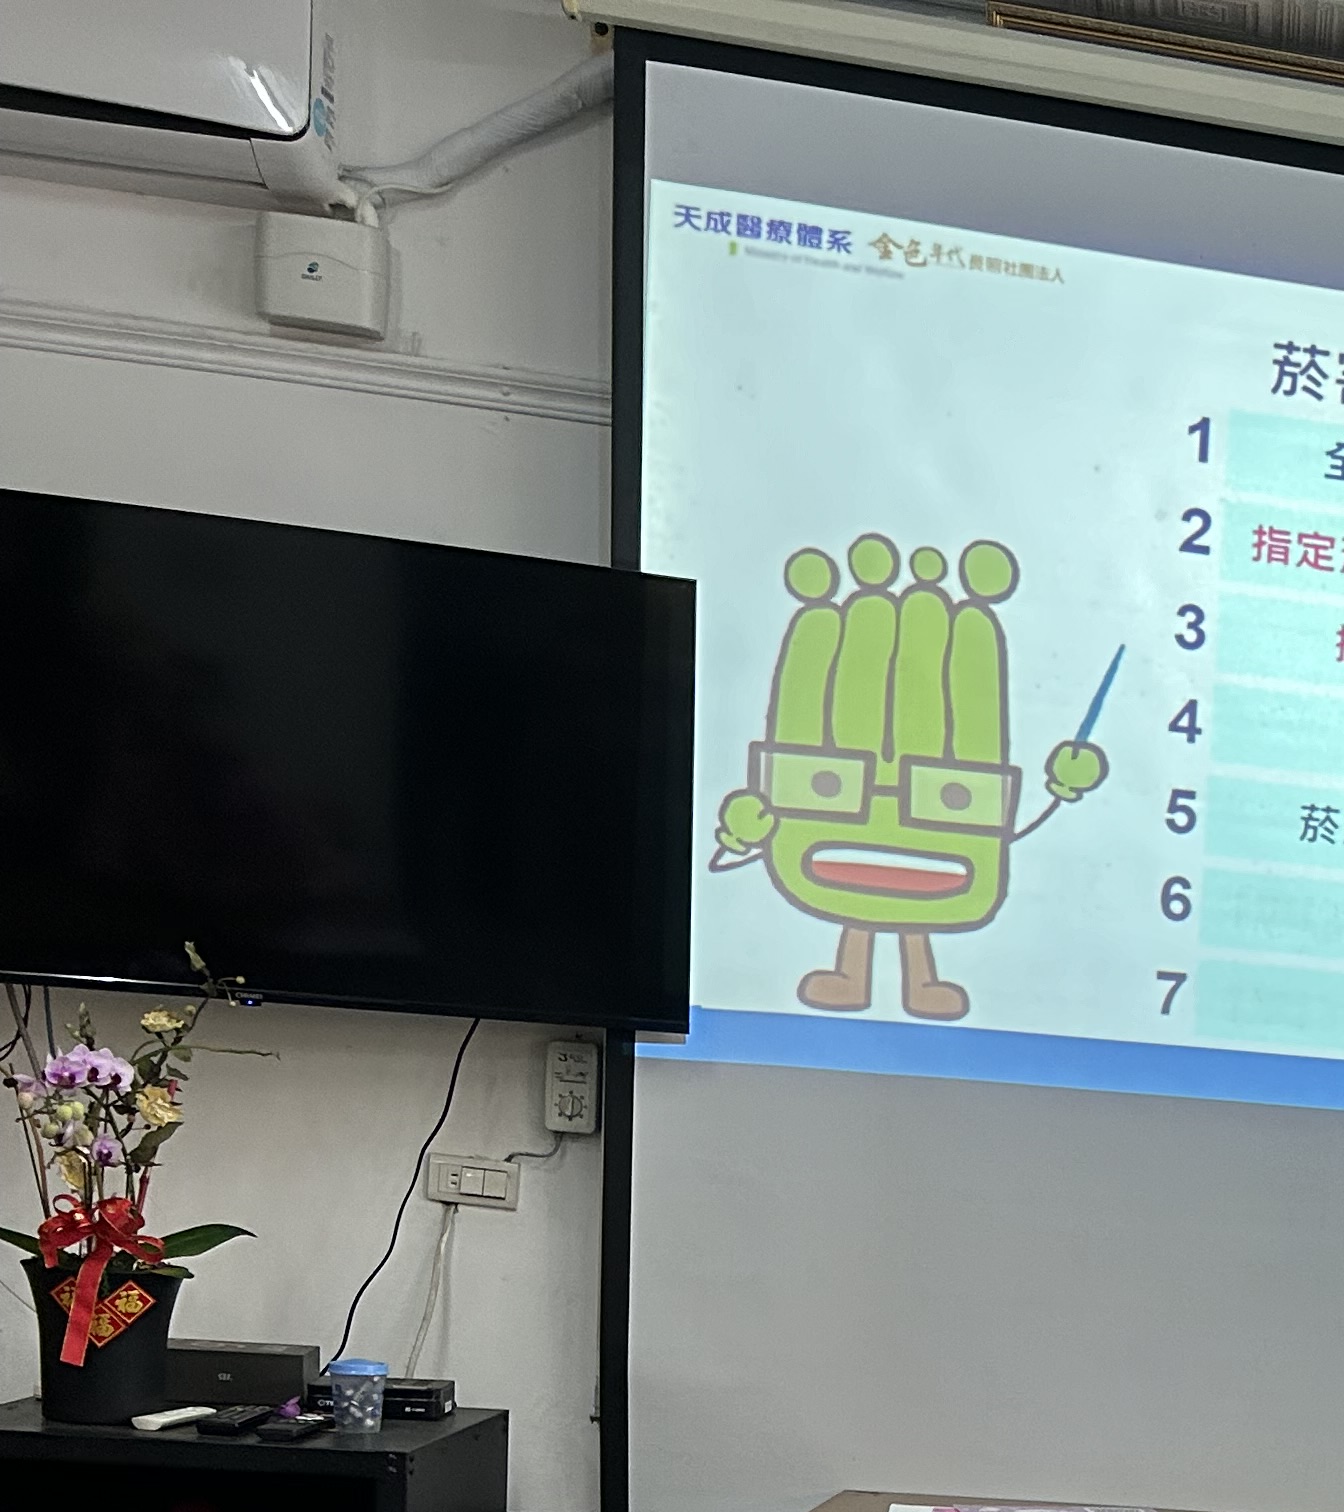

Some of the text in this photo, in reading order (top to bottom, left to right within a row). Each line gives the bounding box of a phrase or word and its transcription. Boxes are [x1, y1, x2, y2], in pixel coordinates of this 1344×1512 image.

[673, 204, 853, 255] 天成醫療體系
[1187, 417, 1213, 463] 1
[1179, 508, 1213, 555] 2
[1174, 604, 1207, 650] 3
[1168, 699, 1202, 744] 4
[1165, 789, 1198, 834] 5
[1160, 875, 1193, 922] 6
[1155, 970, 1187, 1017] 7
[114, 1290, 143, 1313] 福
